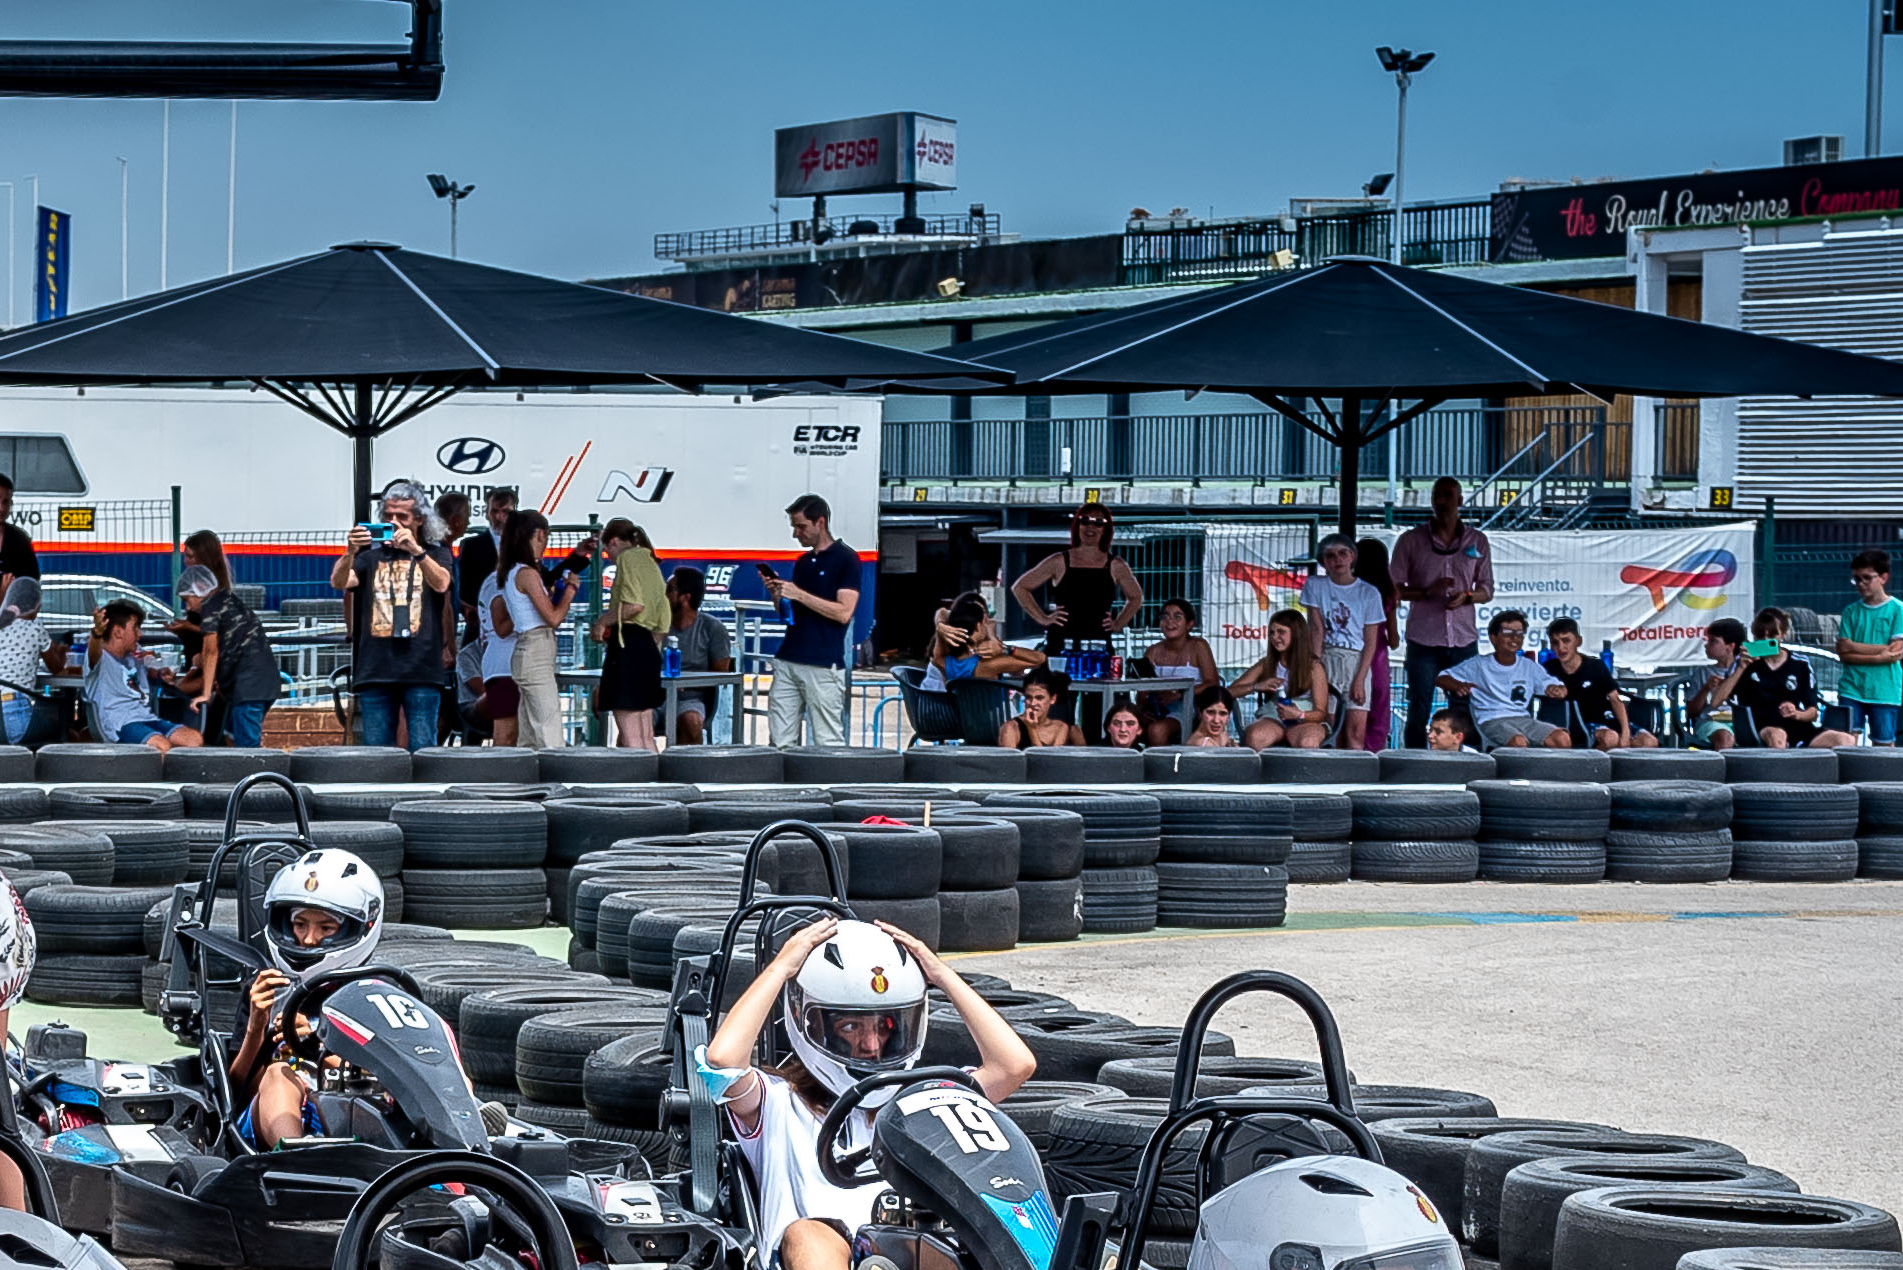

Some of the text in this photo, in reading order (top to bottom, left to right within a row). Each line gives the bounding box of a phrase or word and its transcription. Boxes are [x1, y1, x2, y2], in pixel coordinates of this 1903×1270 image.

[822, 137, 879, 172] CEPSA
[927, 138, 954, 166] CEPSA
[1560, 207, 1595, 238] the
[1675, 189, 1790, 226] Experience
[793, 425, 861, 443] ETCR
[1713, 489, 1730, 505] 33
[60, 513, 92, 526] OMP
[706, 566, 733, 585] 96
[929, 1102, 1011, 1154] 19
